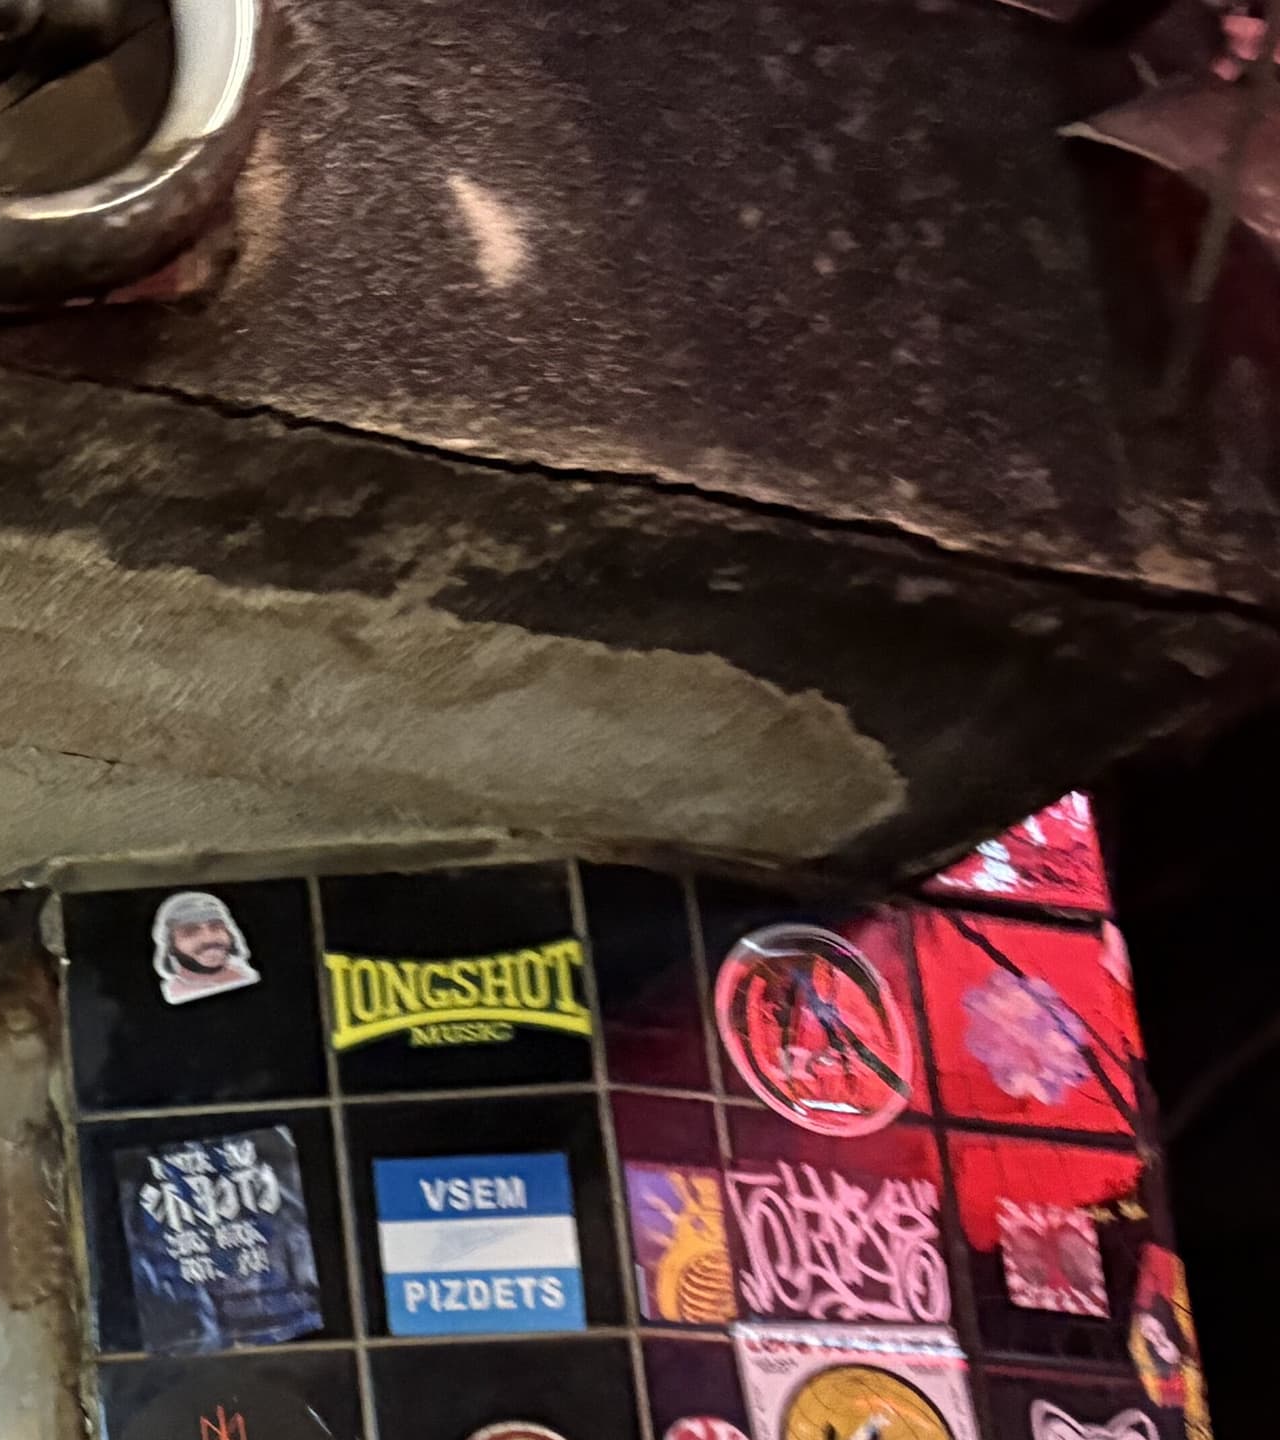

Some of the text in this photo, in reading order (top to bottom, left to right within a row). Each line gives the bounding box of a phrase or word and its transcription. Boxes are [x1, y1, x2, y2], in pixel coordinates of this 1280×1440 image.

[324, 938, 592, 1049] LONGSHOT
[410, 1022, 514, 1048] MUSIC
[418, 1175, 528, 1213] VSEM
[403, 1275, 565, 1315] PIZDETS
